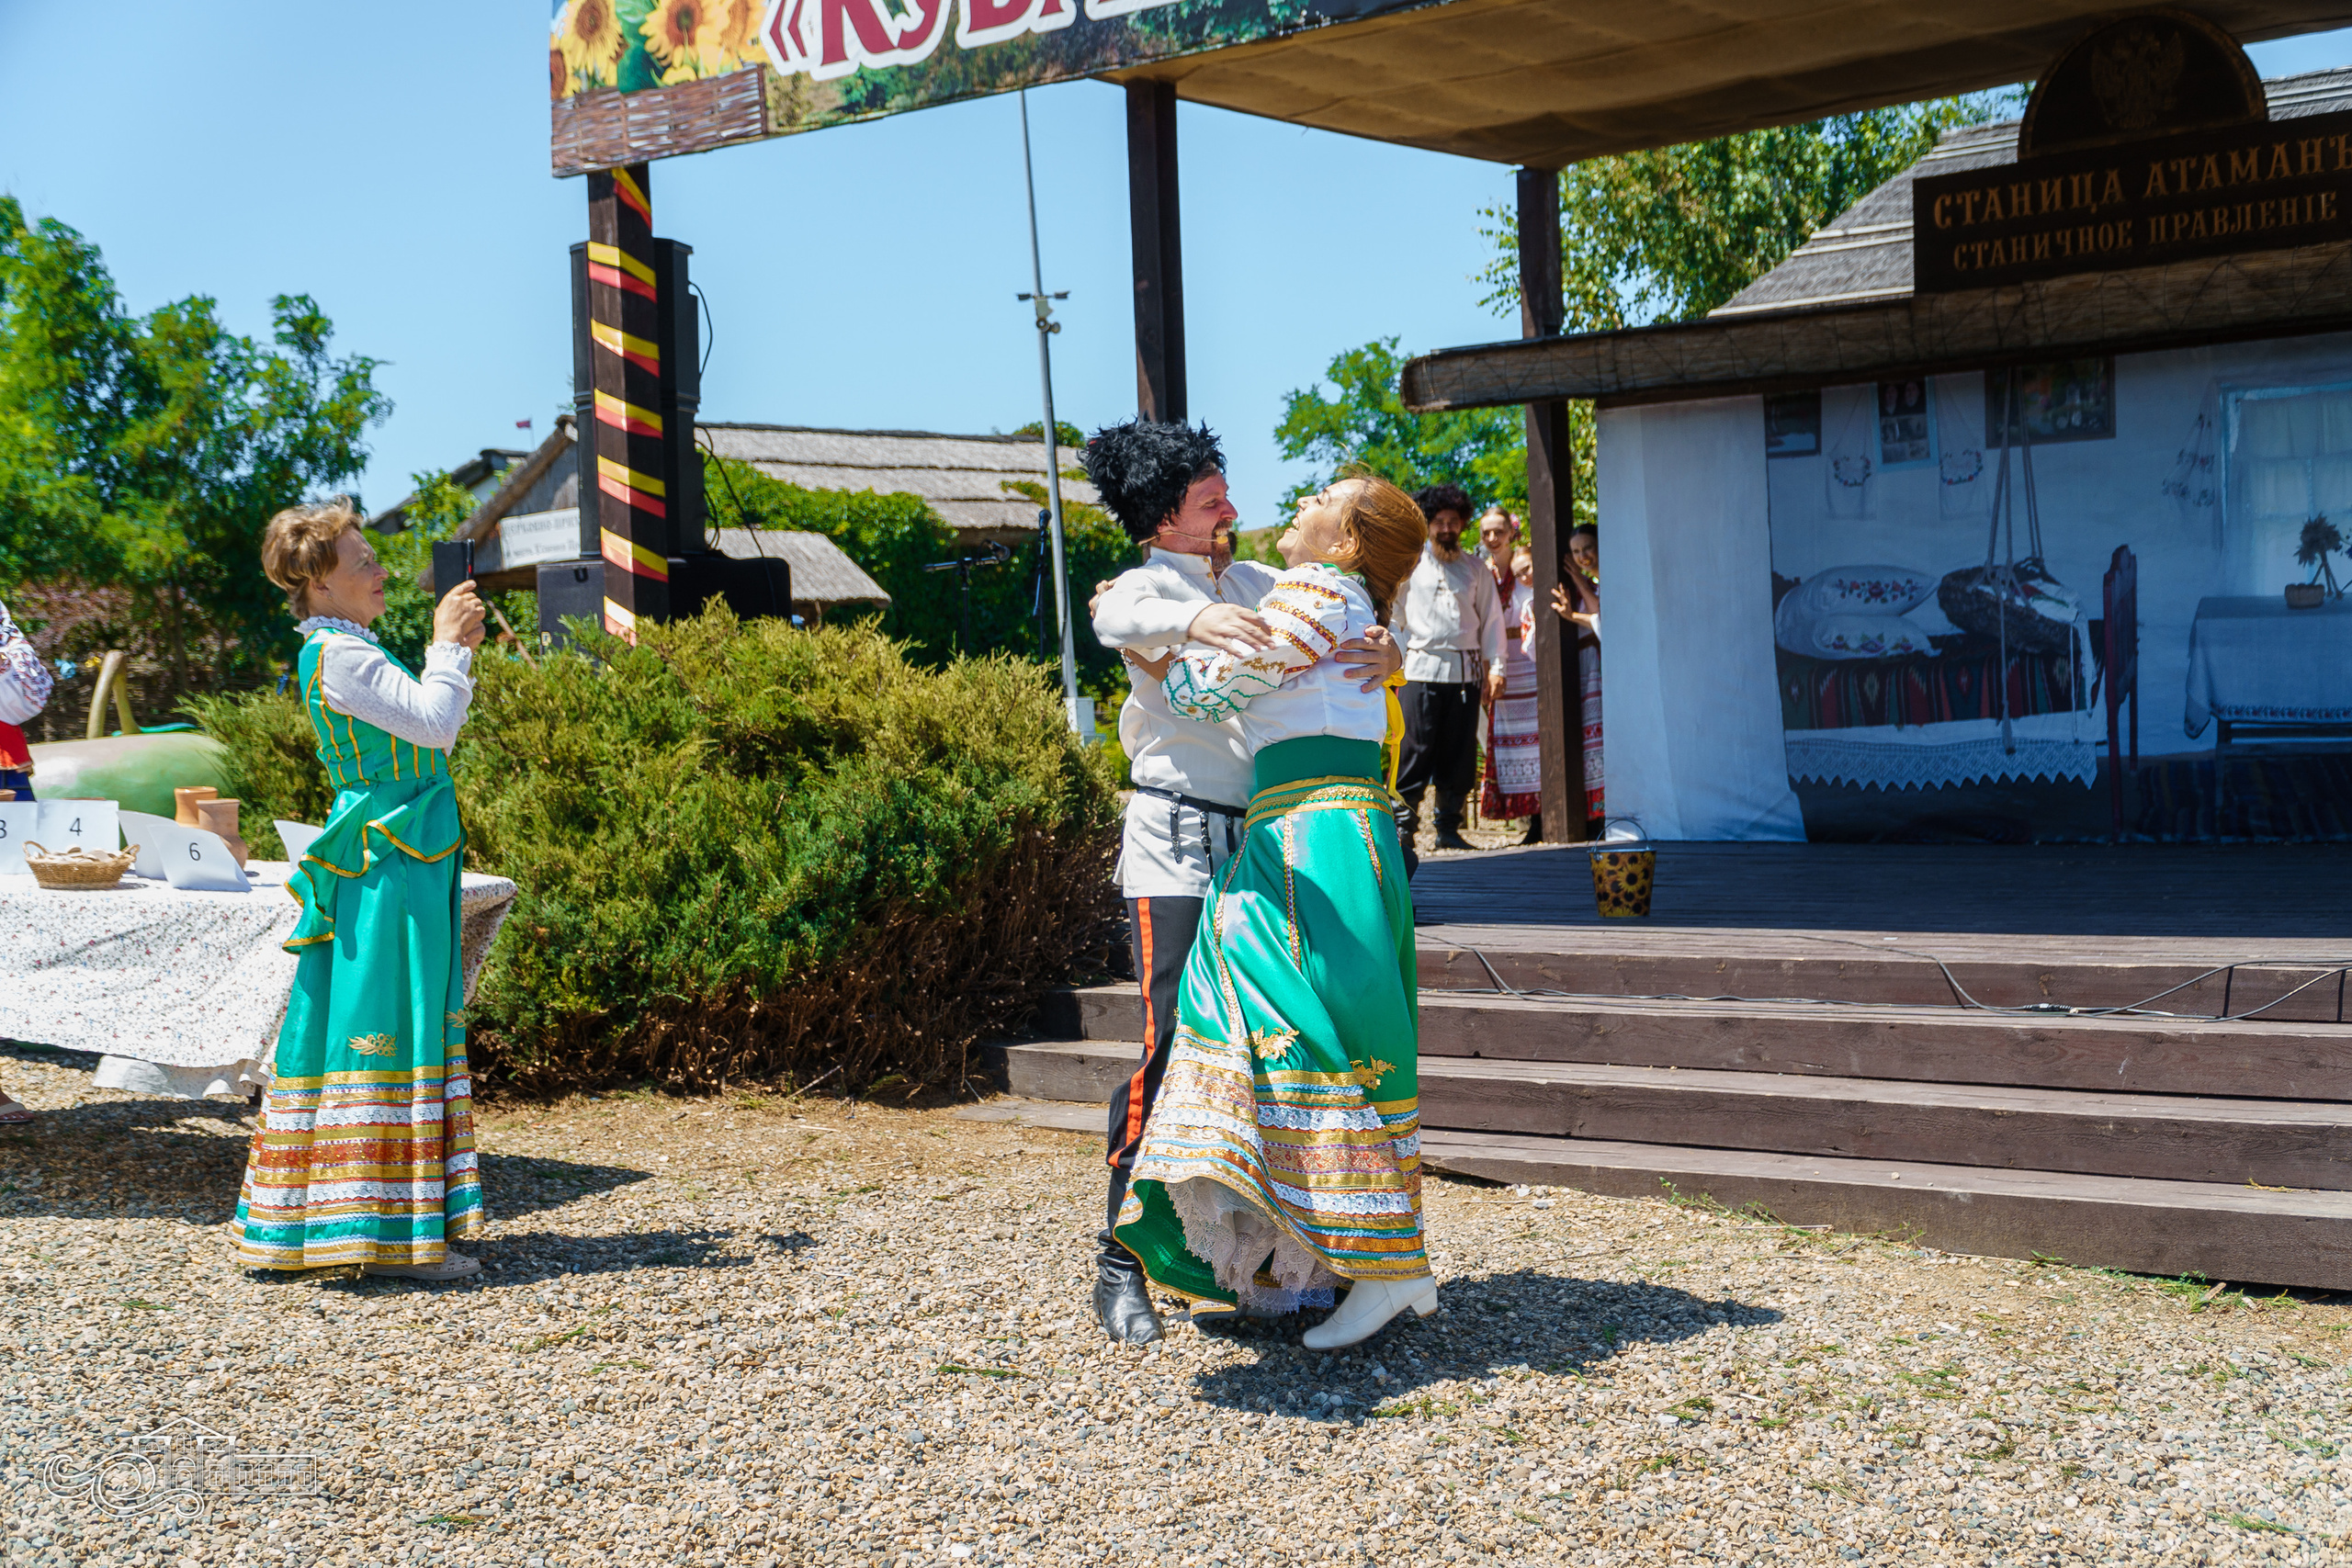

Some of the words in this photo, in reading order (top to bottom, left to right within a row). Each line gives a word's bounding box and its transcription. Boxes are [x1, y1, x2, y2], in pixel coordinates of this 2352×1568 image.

[1934, 167, 2126, 229] СТАНИЦА
[1953, 220, 2133, 271] СТАНИЧНОЕ
[69, 817, 83, 837] 4
[188, 841, 201, 862] 6
